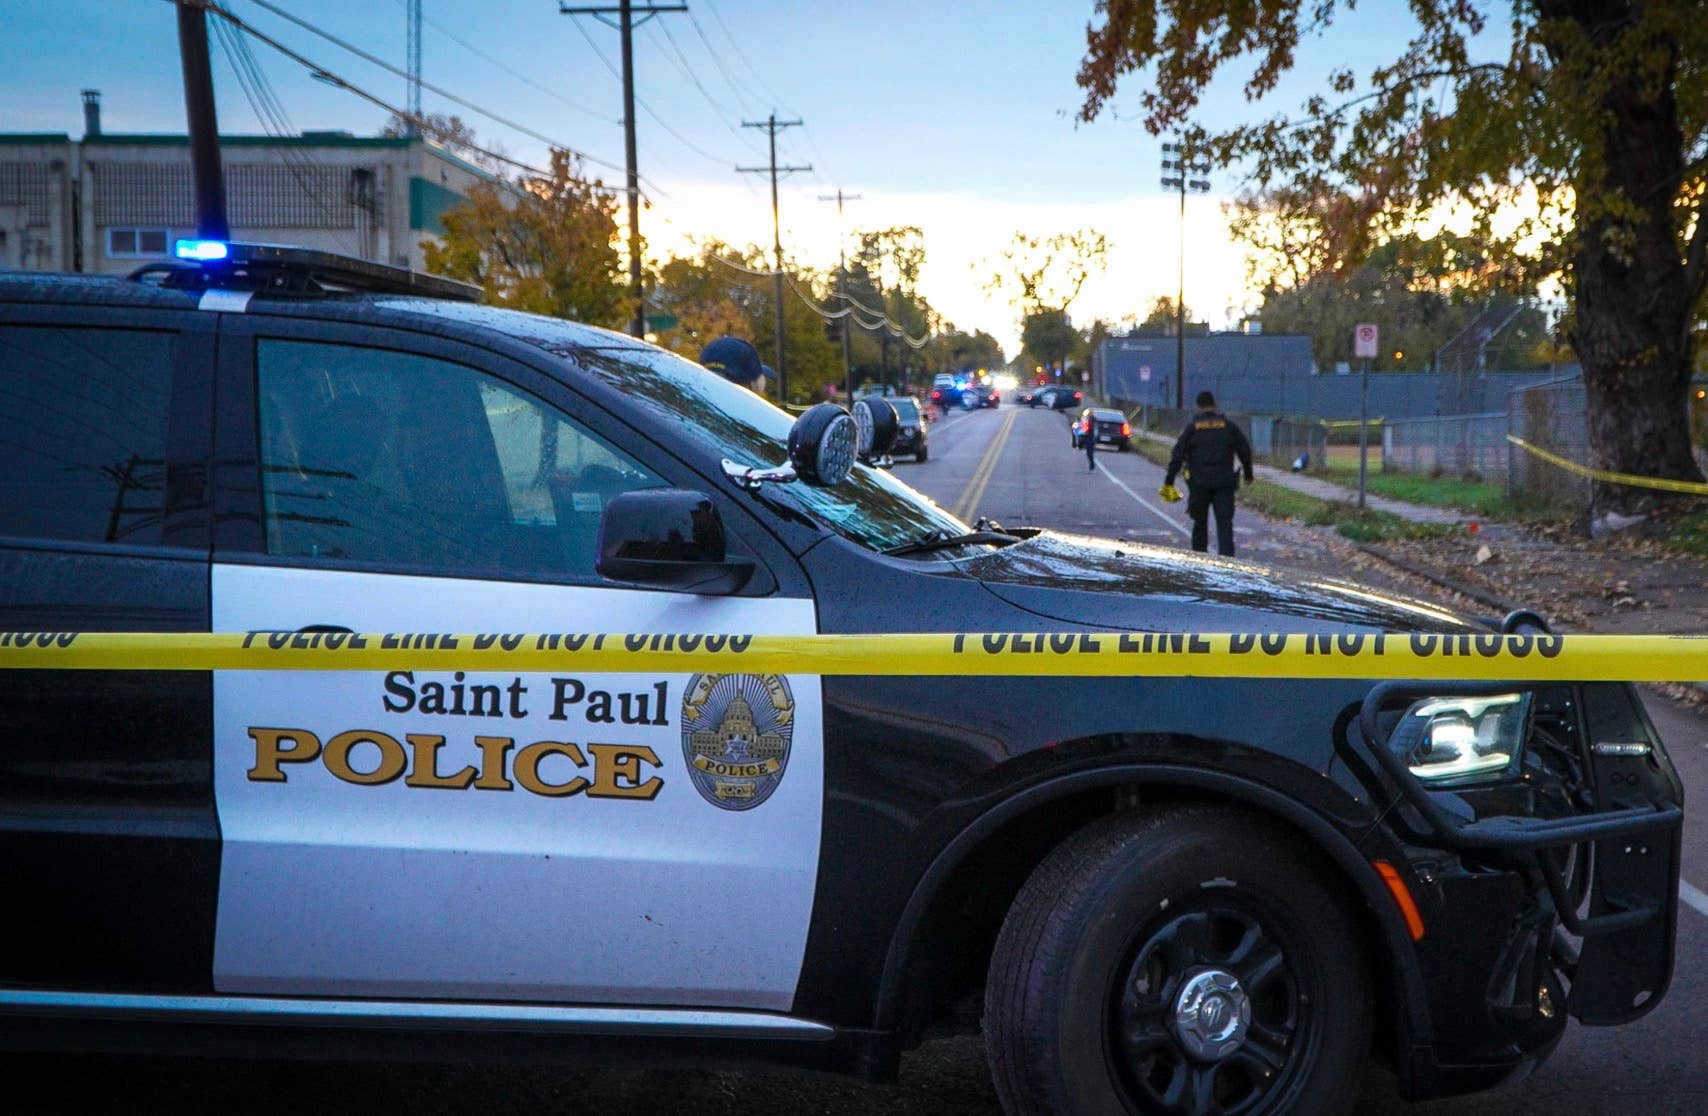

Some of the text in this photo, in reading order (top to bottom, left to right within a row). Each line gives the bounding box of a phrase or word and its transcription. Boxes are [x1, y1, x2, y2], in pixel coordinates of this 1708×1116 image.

[383, 671, 669, 726] Saint Paul
[246, 726, 665, 800] POLICE
[705, 761, 768, 776] POLICE
